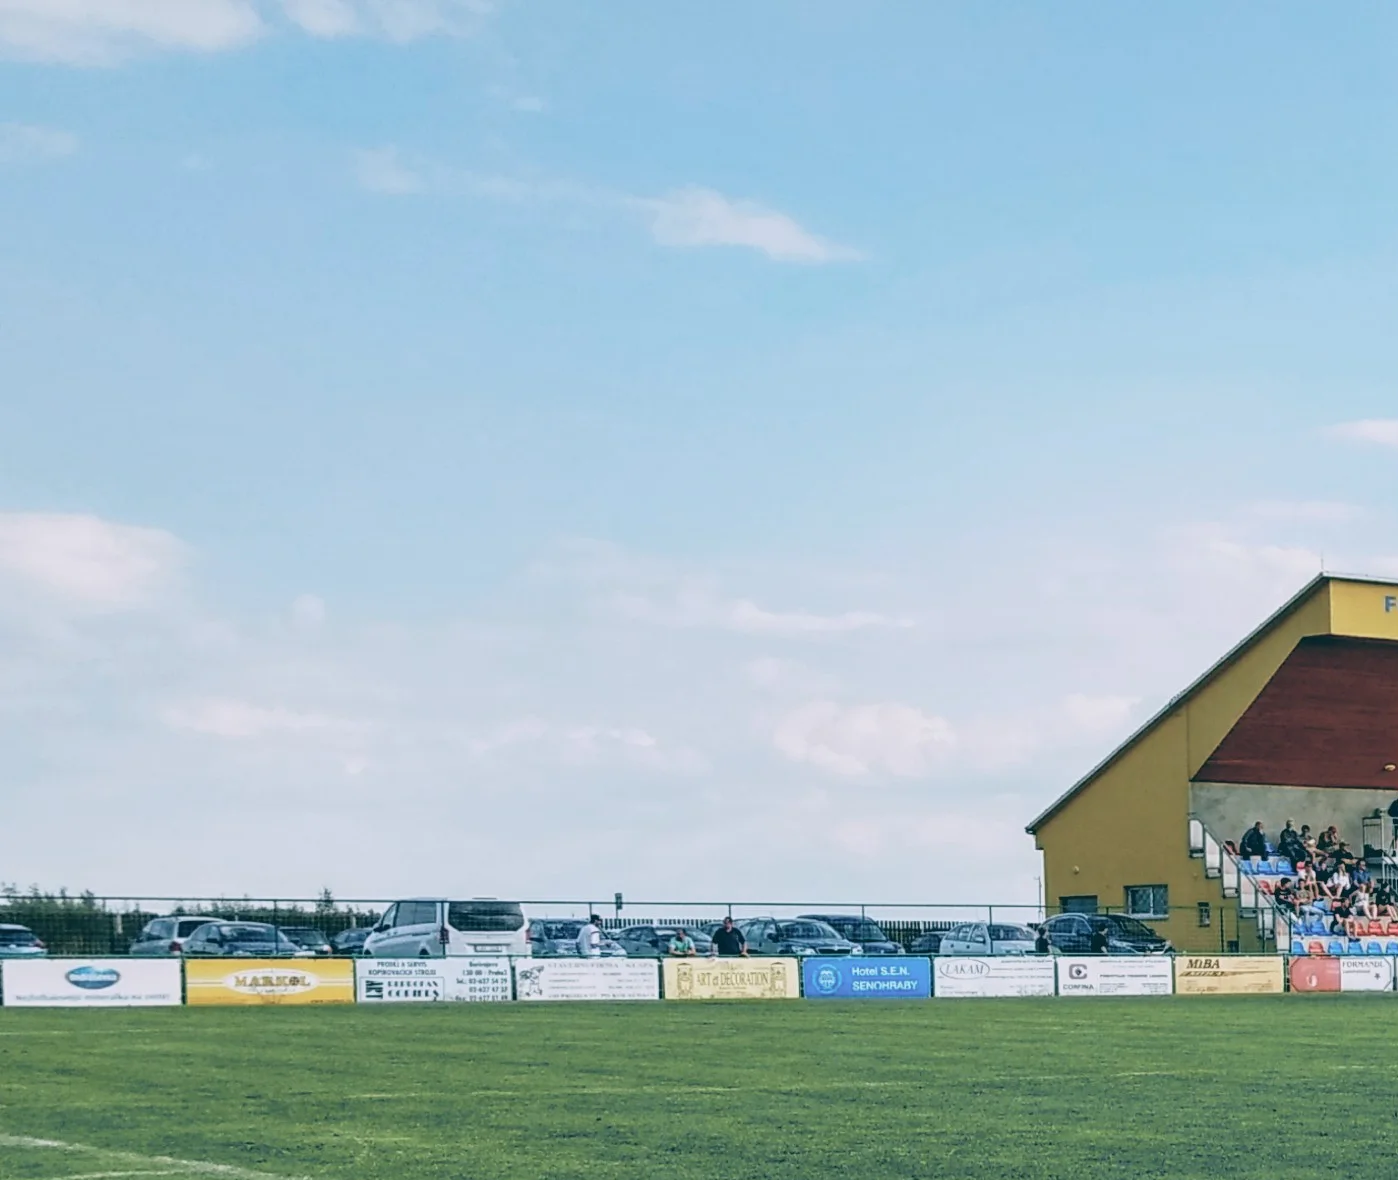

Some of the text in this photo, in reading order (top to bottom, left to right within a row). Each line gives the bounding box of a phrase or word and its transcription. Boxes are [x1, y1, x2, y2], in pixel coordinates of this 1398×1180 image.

[851, 966, 910, 976] Hotel S.E.N.
[945, 964, 984, 975] LAKAM
[852, 980, 918, 991] SENOHRABY
